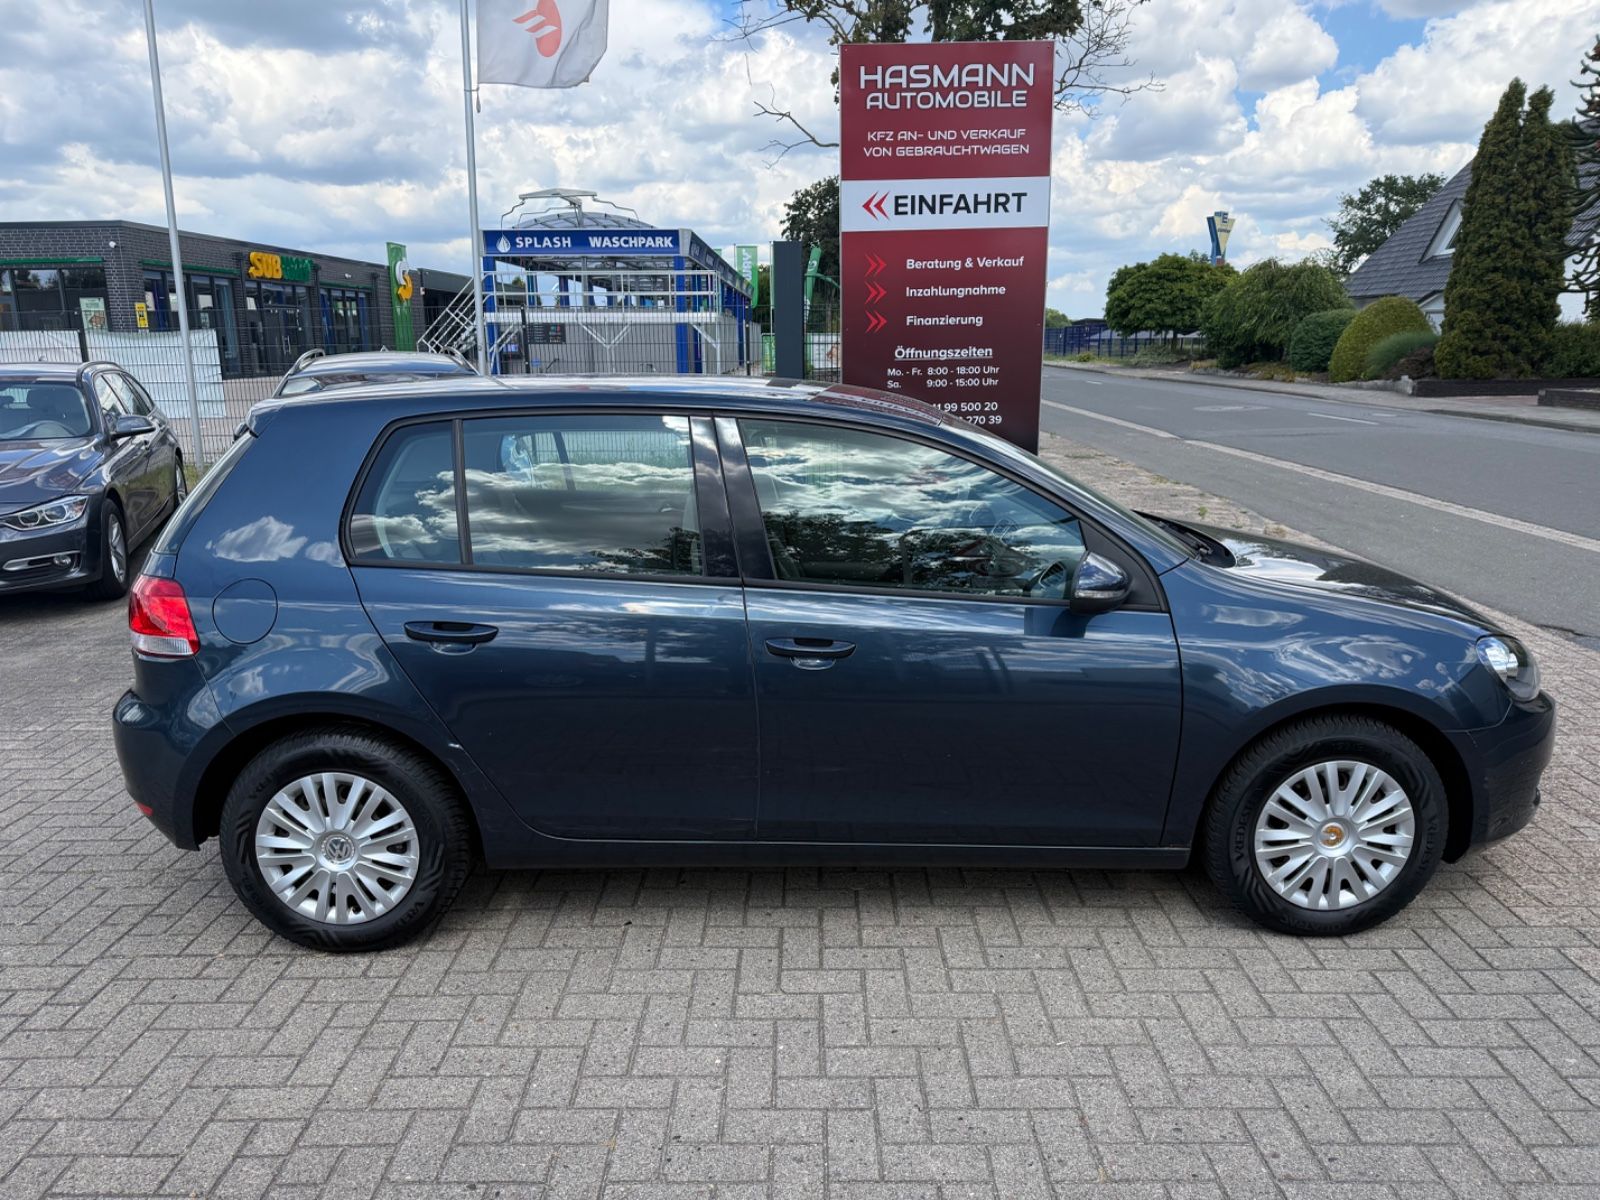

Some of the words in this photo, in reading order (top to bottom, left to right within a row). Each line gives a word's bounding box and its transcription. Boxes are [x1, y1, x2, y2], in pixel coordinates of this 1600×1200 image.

[859, 63, 1035, 89] HASMANN
[866, 90, 1027, 110] AUTOMOBILE
[867, 131, 894, 142] KFZ
[897, 130, 924, 141] AN-
[928, 130, 957, 140] UND
[960, 128, 1026, 140] VERKAUF
[863, 147, 892, 157] VON
[895, 144, 1030, 156] GEBRAUCHTWAGEN
[894, 192, 1027, 216] EINFAHRT
[515, 236, 571, 248] SPLASH
[588, 236, 673, 248] WASCHPARK
[906, 258, 962, 271] Beratung
[965, 258, 974, 268] &
[977, 256, 1024, 268] Verkauf
[906, 285, 1006, 299] Inzahlungnahme
[906, 315, 984, 327] Finanzierung
[894, 346, 993, 360] Öffnungszeiten
[887, 368, 904, 377] Mo.
[911, 367, 923, 376] Fr.
[927, 367, 948, 375] 8:00
[956, 366, 981, 375] 18:00
[983, 365, 1000, 374] Uhr
[887, 380, 902, 389] Sa.
[926, 379, 948, 387] 9:00
[955, 378, 980, 387] 15:00
[982, 377, 999, 386] Uhr
[944, 403, 958, 412] 99
[960, 402, 981, 411] 500
[984, 401, 998, 411] 20
[966, 416, 985, 425] 270
[988, 415, 1002, 424] 39
